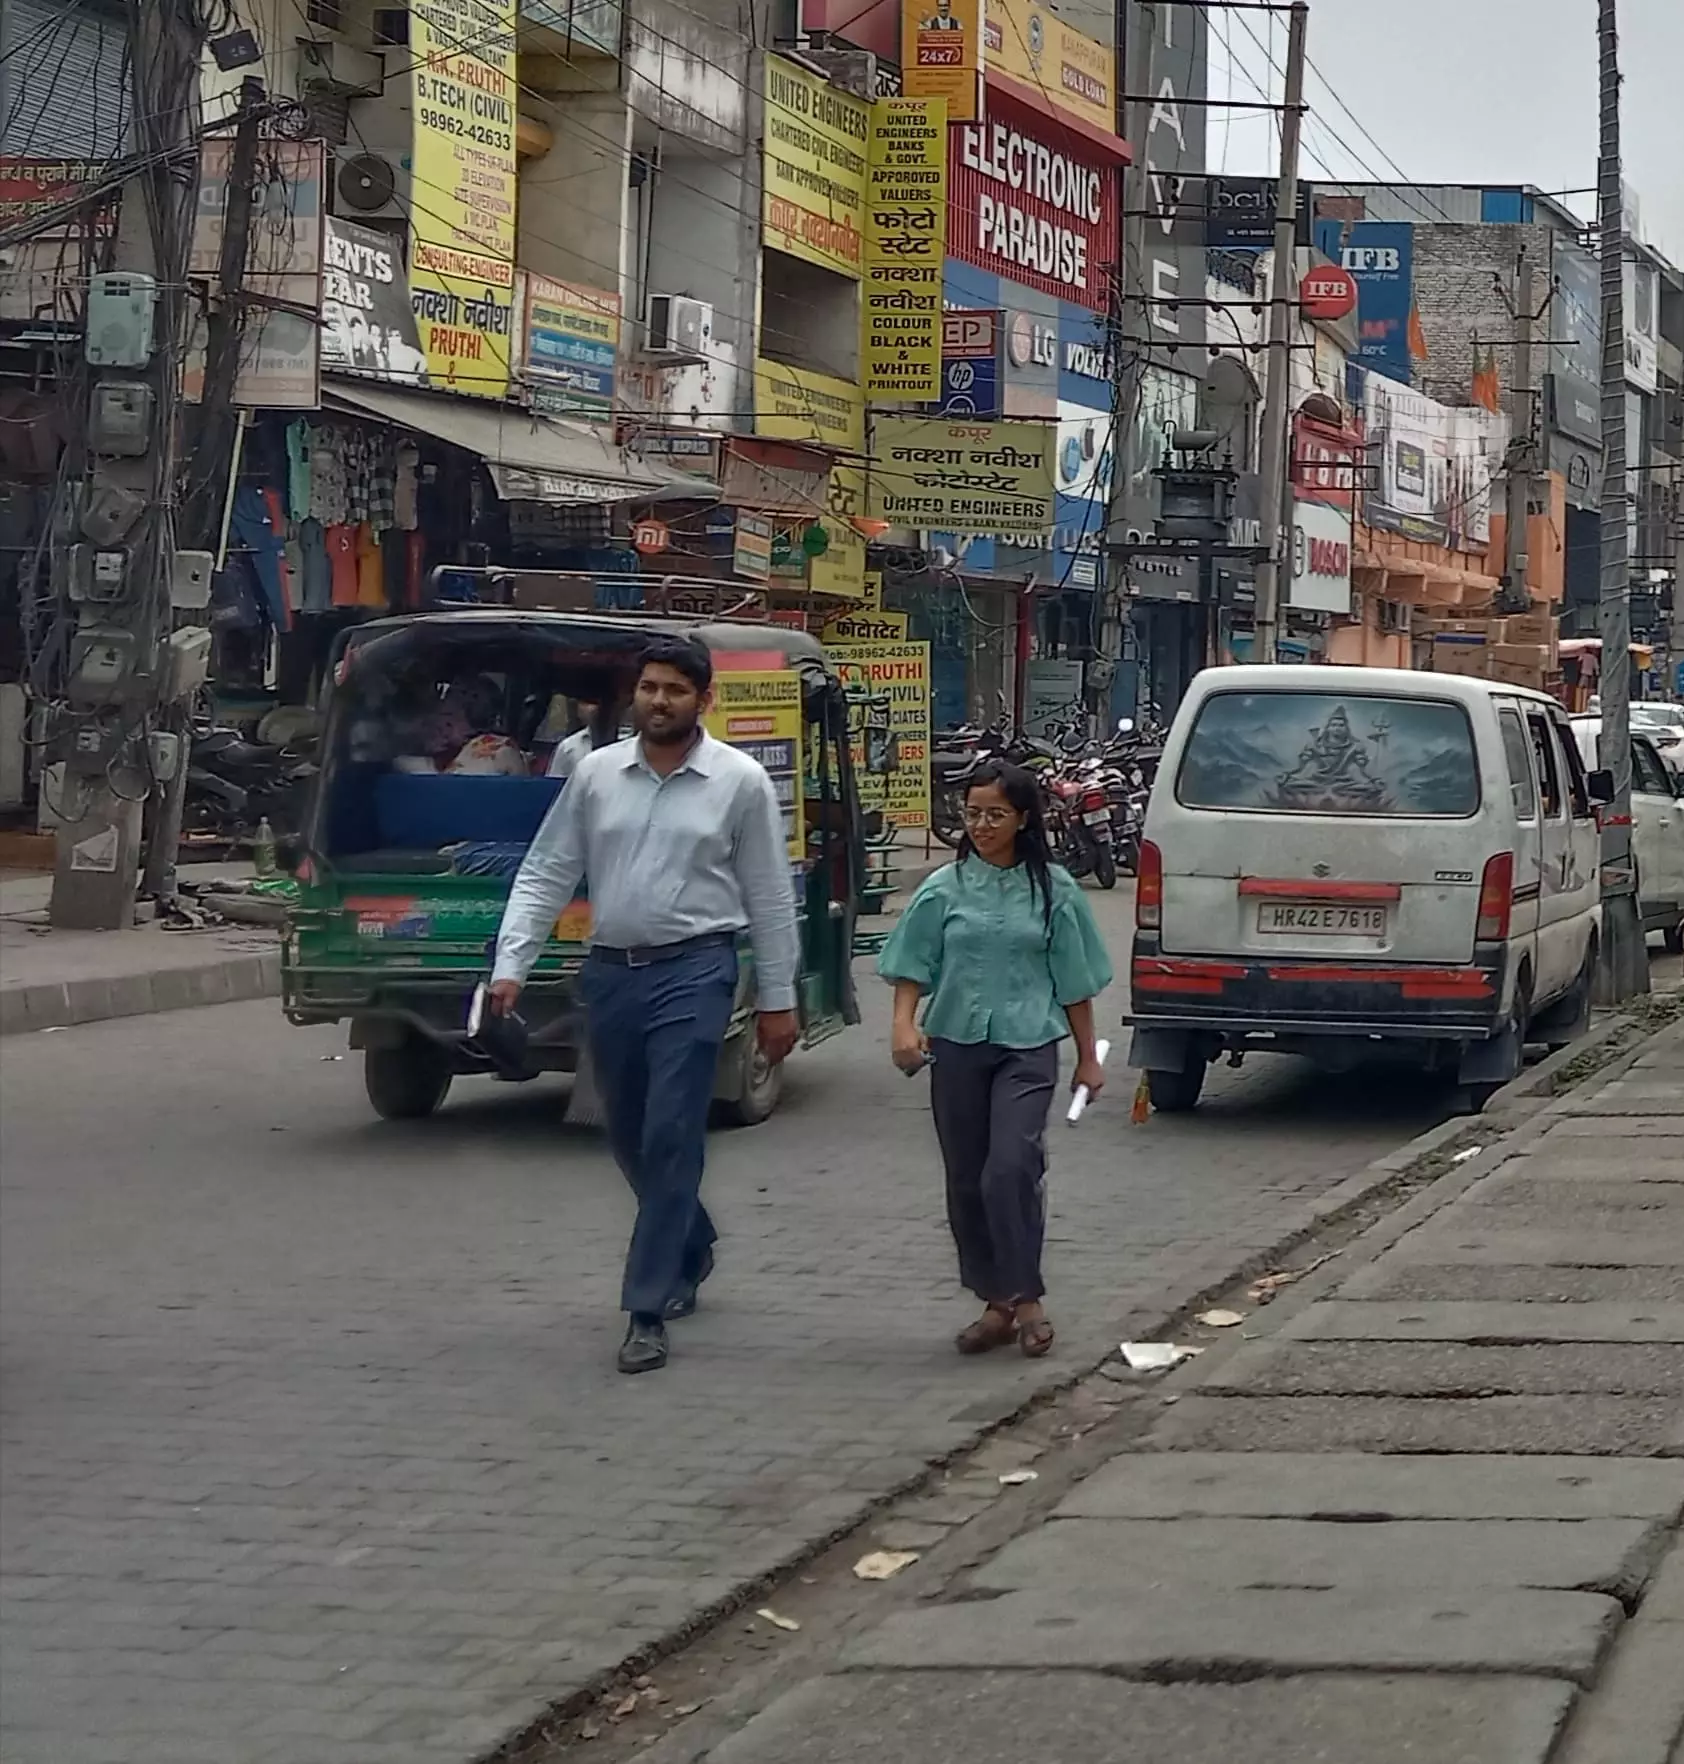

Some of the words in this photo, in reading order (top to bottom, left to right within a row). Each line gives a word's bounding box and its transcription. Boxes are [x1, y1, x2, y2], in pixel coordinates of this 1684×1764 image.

[920, 49, 953, 63] 24x7
[458, 60, 506, 96] PRUTHI
[417, 74, 466, 111] B.TECH
[470, 92, 513, 129] (CIVIL)
[770, 69, 810, 114] UNITED
[812, 87, 868, 143] ENGINEERS
[421, 108, 512, 151] 98962-42633
[887, 115, 927, 126] UNITED
[876, 128, 937, 138] ENGINEERS
[888, 141, 925, 151] BANKS
[885, 154, 893, 164] &
[896, 154, 928, 164] GOVT.
[963, 117, 1101, 225] ELECTRONIC
[880, 188, 932, 201] VALUERS
[873, 207, 938, 230] फोटो
[878, 231, 932, 254] स्टेट
[979, 194, 1088, 289] PARADISE
[1340, 247, 1400, 271] IFB
[870, 266, 937, 282] नक्शा
[1308, 281, 1348, 297] IFB
[869, 289, 937, 310] नवीश
[872, 317, 932, 330] COLOUR
[429, 326, 482, 361] PRUTHI
[870, 335, 932, 347] BLACK
[1034, 323, 1056, 367] LG
[898, 351, 908, 360] &
[871, 363, 932, 376] WHITE
[868, 380, 933, 390] PRINTOUT
[948, 425, 992, 444] कपूर
[891, 446, 962, 465] नक्शा
[969, 446, 1042, 469] नवीश
[883, 496, 944, 513] UNITED
[950, 499, 1046, 518] ENGINEERS
[1307, 536, 1348, 577] BOSCH
[836, 617, 901, 640] फोटोस्टेट
[825, 646, 925, 660] ob:-98962-42633
[868, 709, 926, 726] ASSCIATES
[855, 778, 923, 790] LEVATION
[1273, 908, 1319, 928] HR42
[1323, 909, 1333, 928] E
[1337, 910, 1383, 929] 7618
